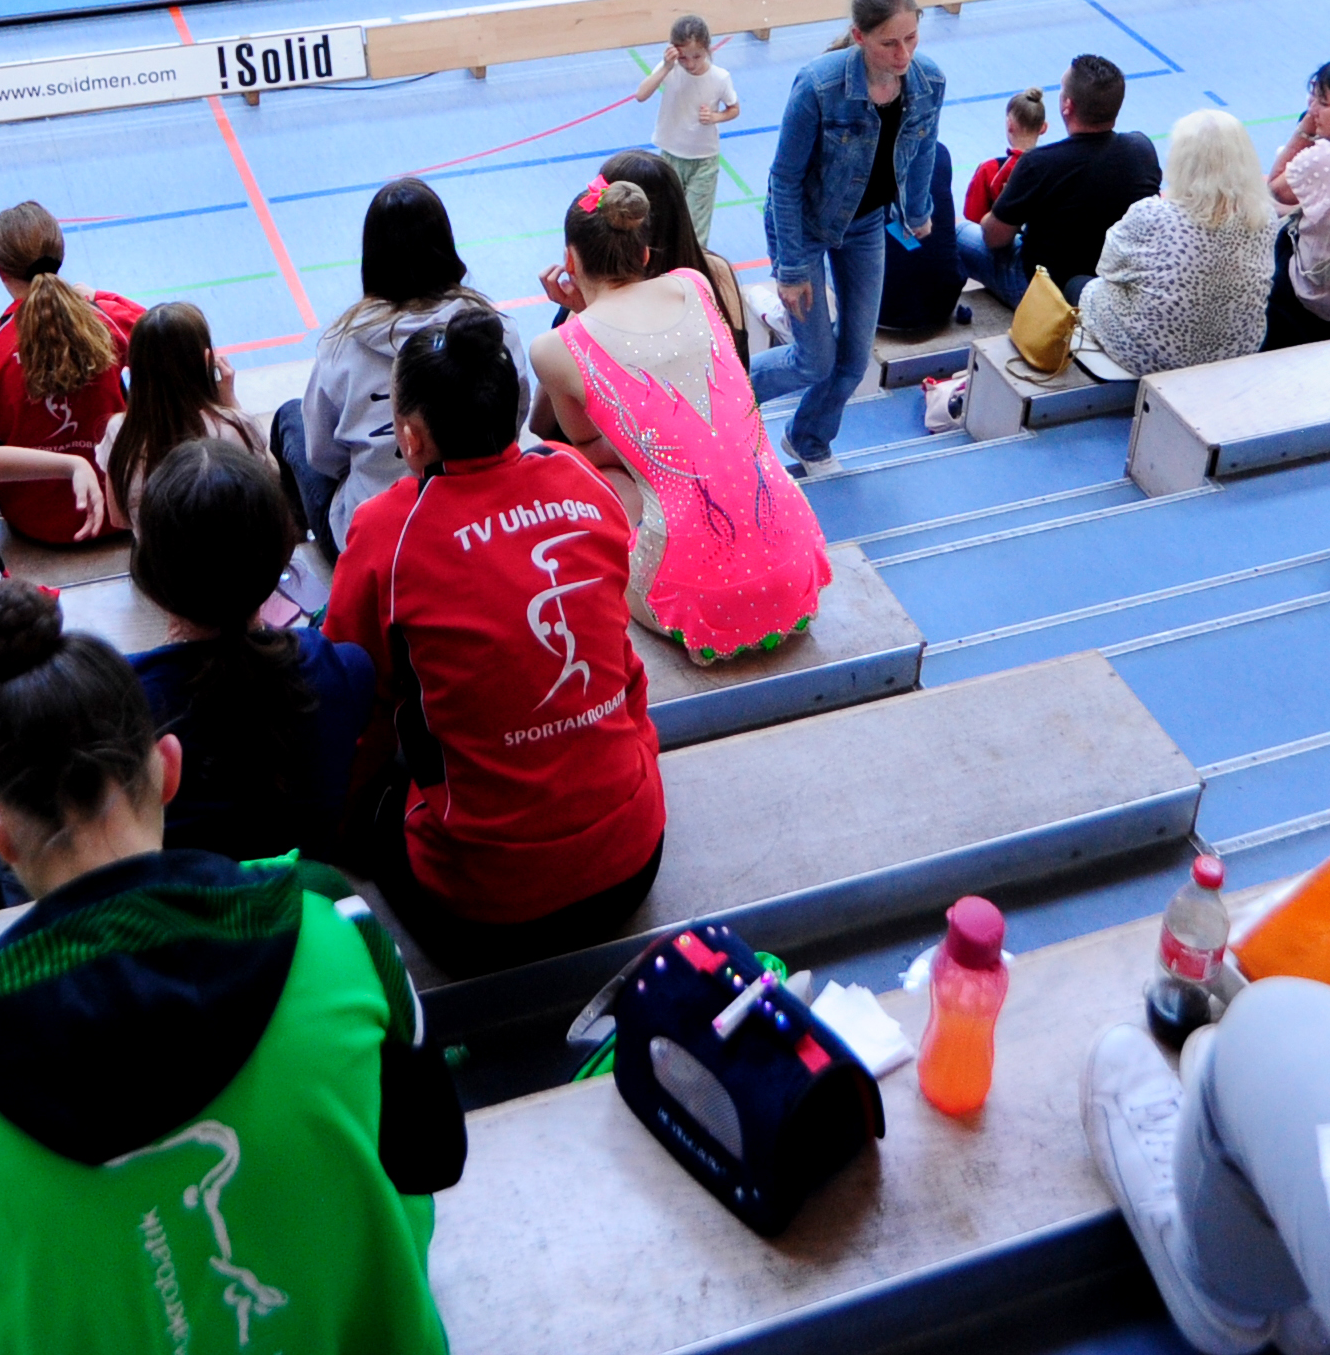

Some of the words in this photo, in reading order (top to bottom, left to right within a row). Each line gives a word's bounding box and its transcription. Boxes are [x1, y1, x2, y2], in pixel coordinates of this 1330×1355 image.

[217, 33, 333, 90] !Solid
[453, 516, 492, 552] TV
[498, 498, 602, 533] Uhingen
[504, 685, 627, 747] SPORTAKROBATI
